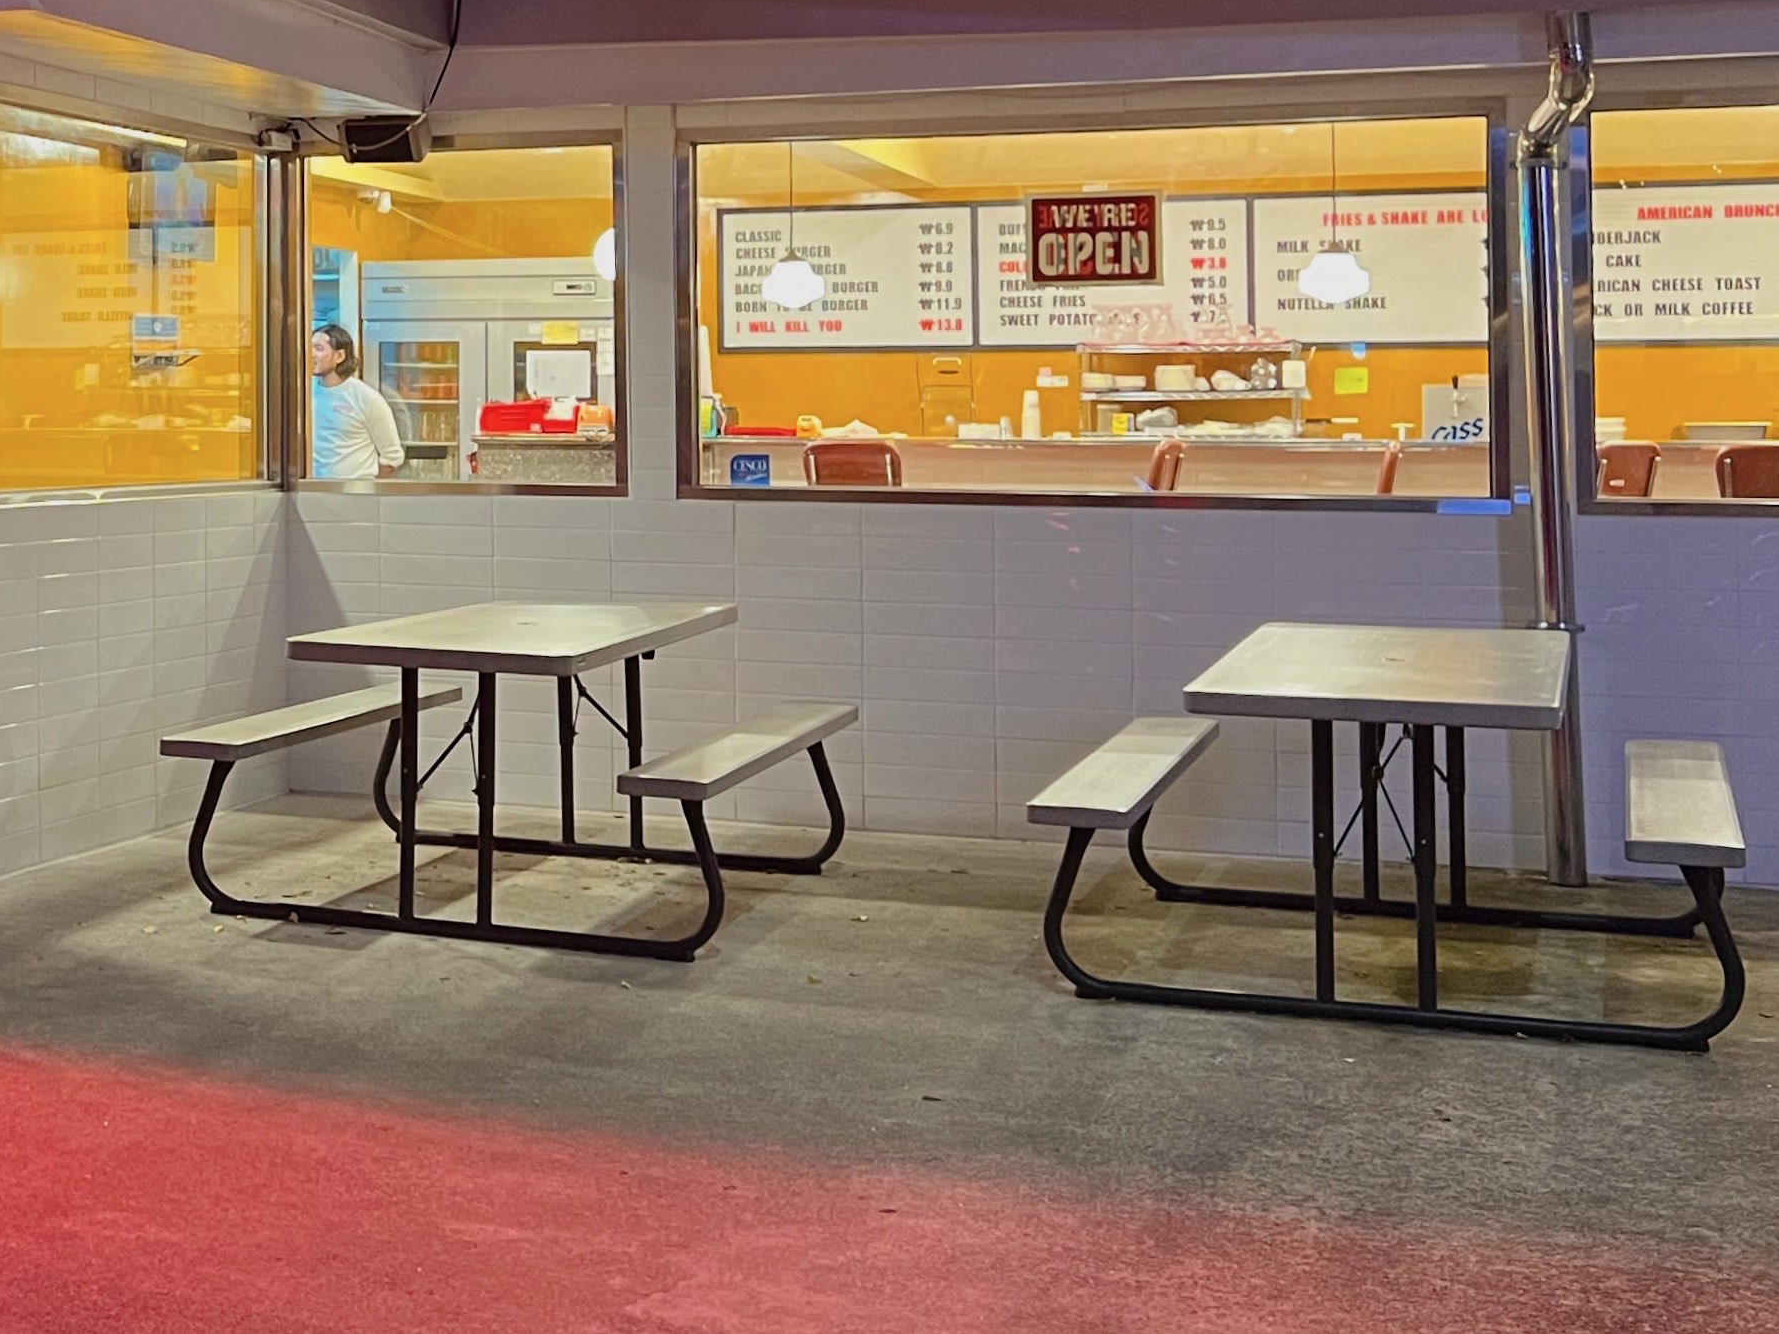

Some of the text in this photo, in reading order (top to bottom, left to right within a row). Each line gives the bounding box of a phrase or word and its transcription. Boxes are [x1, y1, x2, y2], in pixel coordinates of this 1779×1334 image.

[1323, 213, 1362, 226] FRIES
[1367, 213, 1376, 226] &
[1381, 211, 1428, 226] SHAKE
[1437, 210, 1464, 224] ARE
[1637, 206, 1713, 220] AMERICAN
[735, 230, 782, 243] CLASSIC
[736, 247, 777, 259] CHEESE
[1277, 240, 1309, 253] MILK
[1038, 231, 1150, 276] OPEN
[1606, 254, 1642, 267] CAKE
[832, 281, 878, 293] BURGER
[1652, 278, 1703, 291] CHEESE
[1715, 277, 1761, 290] TOAST
[735, 301, 767, 313] BORN
[822, 299, 869, 311] BURGER
[1000, 296, 1043, 308] CHEESE
[1053, 295, 1086, 307] FRIES
[1345, 297, 1386, 309] SHAKE
[1624, 303, 1643, 316] OR
[1655, 303, 1691, 316] MILK
[1702, 301, 1753, 315] COFFEE
[749, 320, 777, 333] WILL
[785, 320, 810, 332] KILL
[819, 319, 843, 331] YOU
[1000, 314, 1039, 326] SWEET
